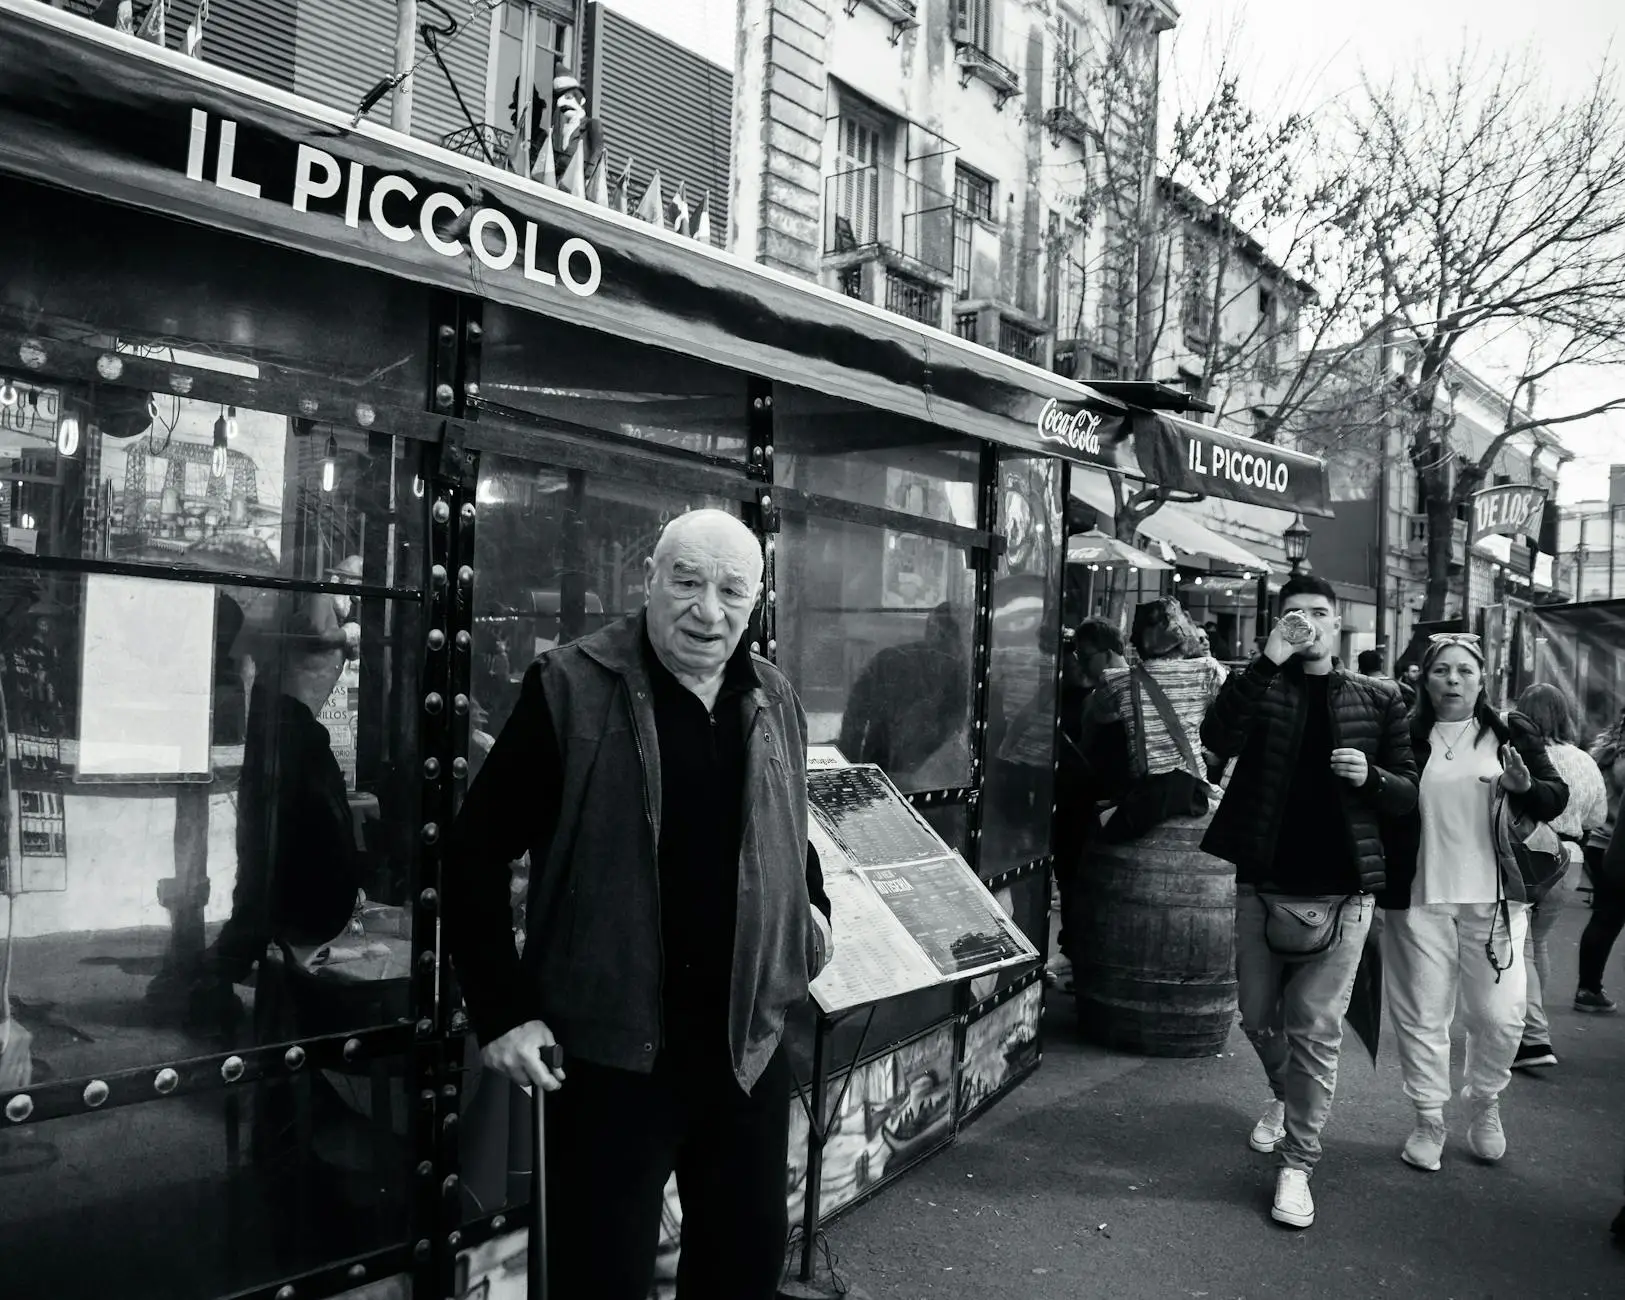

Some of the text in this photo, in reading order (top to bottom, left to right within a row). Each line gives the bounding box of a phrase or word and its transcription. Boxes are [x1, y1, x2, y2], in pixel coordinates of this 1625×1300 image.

[186, 107, 602, 297] IL PICCOLO
[1037, 397, 1103, 456] Coca-Cola
[1188, 438, 1289, 493] IL PICCOLO
[1474, 494, 1500, 532] DE
[1500, 490, 1533, 529] LOS
